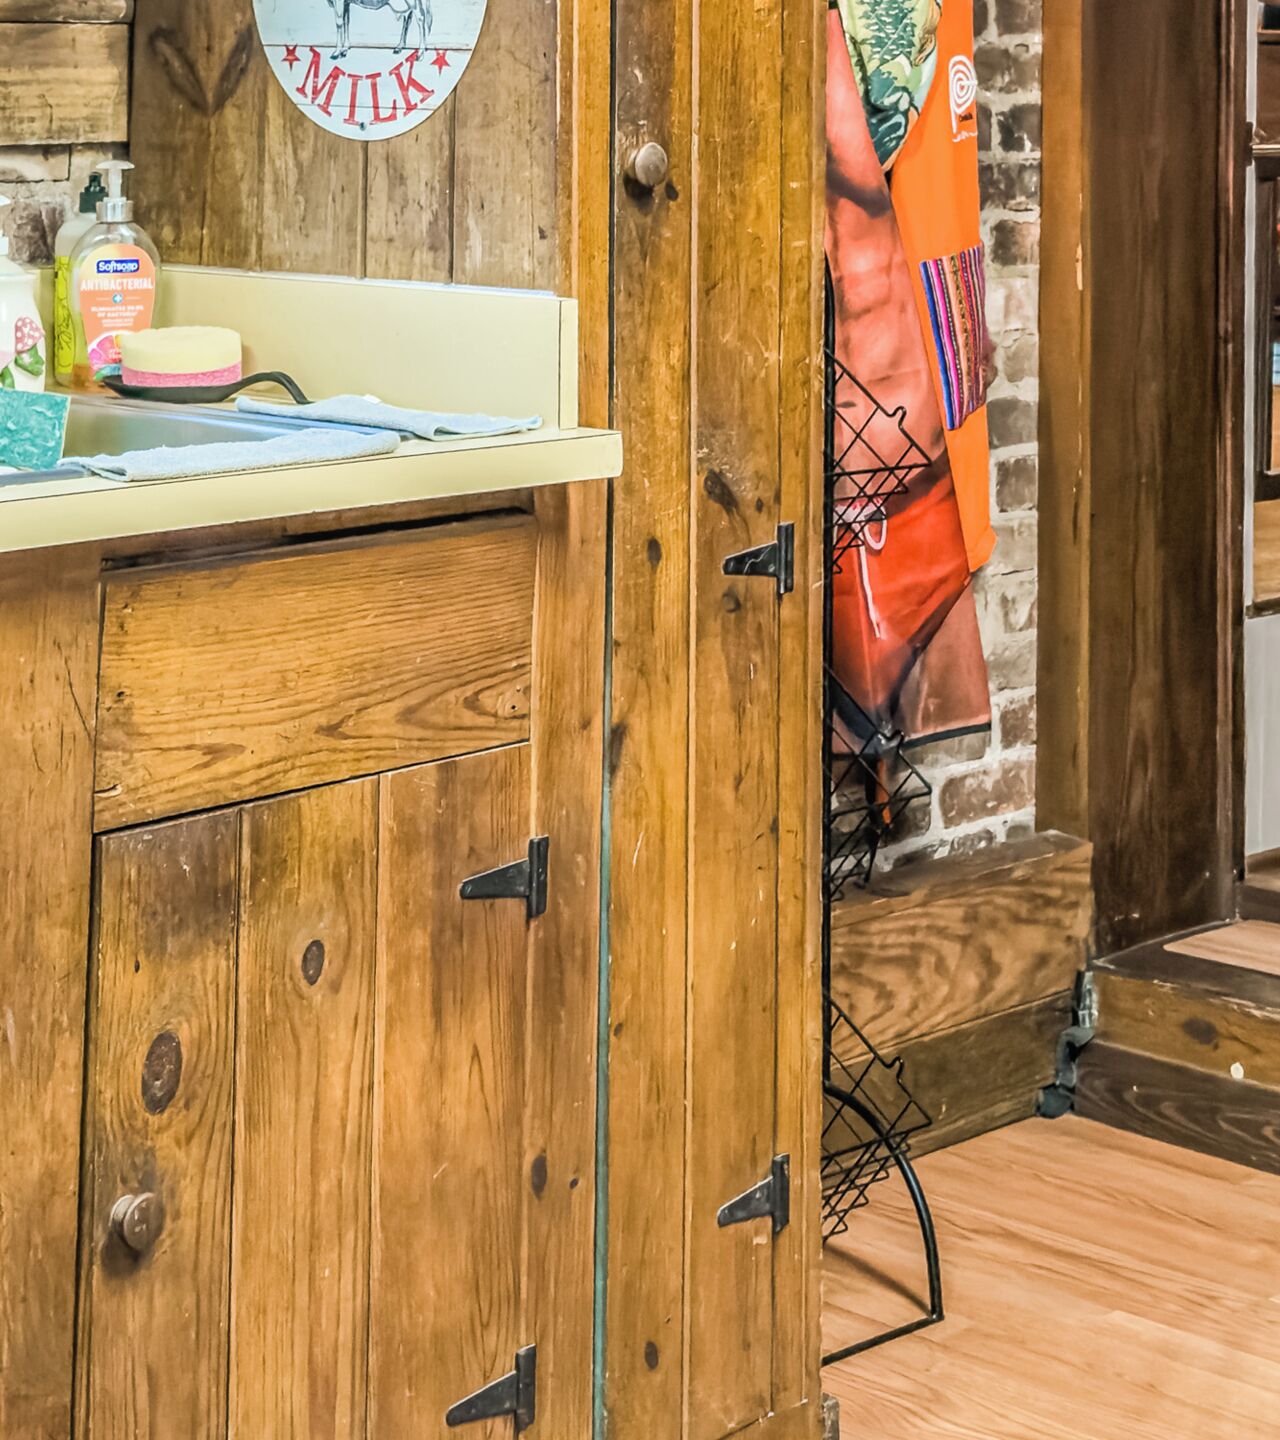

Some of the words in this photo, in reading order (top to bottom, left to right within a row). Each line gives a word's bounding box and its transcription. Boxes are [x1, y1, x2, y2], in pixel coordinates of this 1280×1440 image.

[295, 45, 436, 126] MILK
[98, 260, 138, 273] Softsoap
[80, 277, 154, 291] ANTIBACTERIAL
